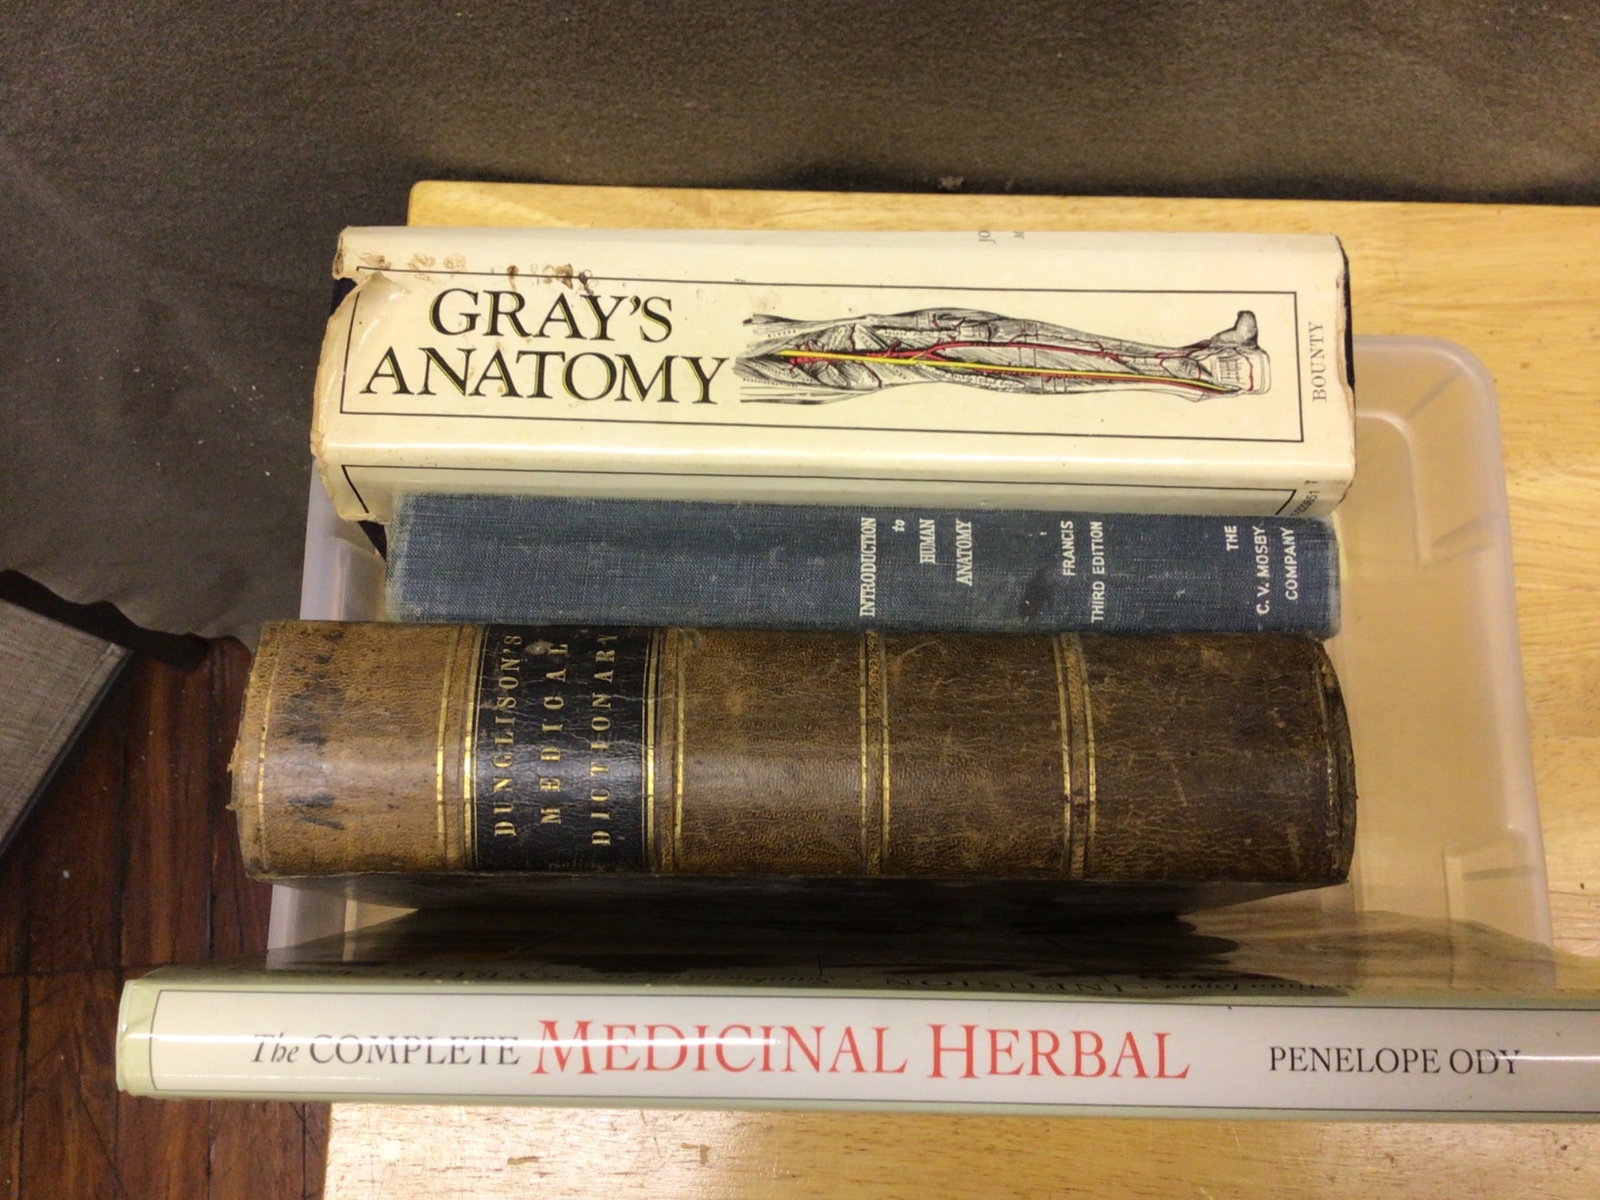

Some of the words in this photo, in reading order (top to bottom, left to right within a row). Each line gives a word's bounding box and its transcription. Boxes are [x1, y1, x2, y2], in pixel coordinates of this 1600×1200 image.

[429, 288, 673, 343] GRAY'S
[359, 345, 730, 405] ANATOMY
[1308, 320, 1327, 403] BOUNTY
[892, 518, 906, 533] to
[919, 518, 936, 565] HUMAN
[956, 518, 973, 588] ANATOMY
[1061, 520, 1074, 577] FRANCIS
[1090, 521, 1104, 575] EDITION
[1224, 525, 1239, 551] THE
[1252, 526, 1271, 578] MOSBY
[859, 517, 877, 618] INTRODUCTION
[1280, 526, 1298, 601] COMPANY
[1091, 580, 1106, 624] THIRD
[493, 634, 523, 838] DUNGLISON'S
[540, 643, 569, 825] MEDICAL
[590, 633, 618, 847] DICTIONARY
[250, 1032, 302, 1064] The
[308, 1033, 522, 1066] COMPLETE
[530, 1020, 908, 1075] MEDICINAL
[927, 1023, 1192, 1080] HERBAL
[1268, 1045, 1441, 1075] PENELOPE
[1448, 1047, 1522, 1076] ODY
